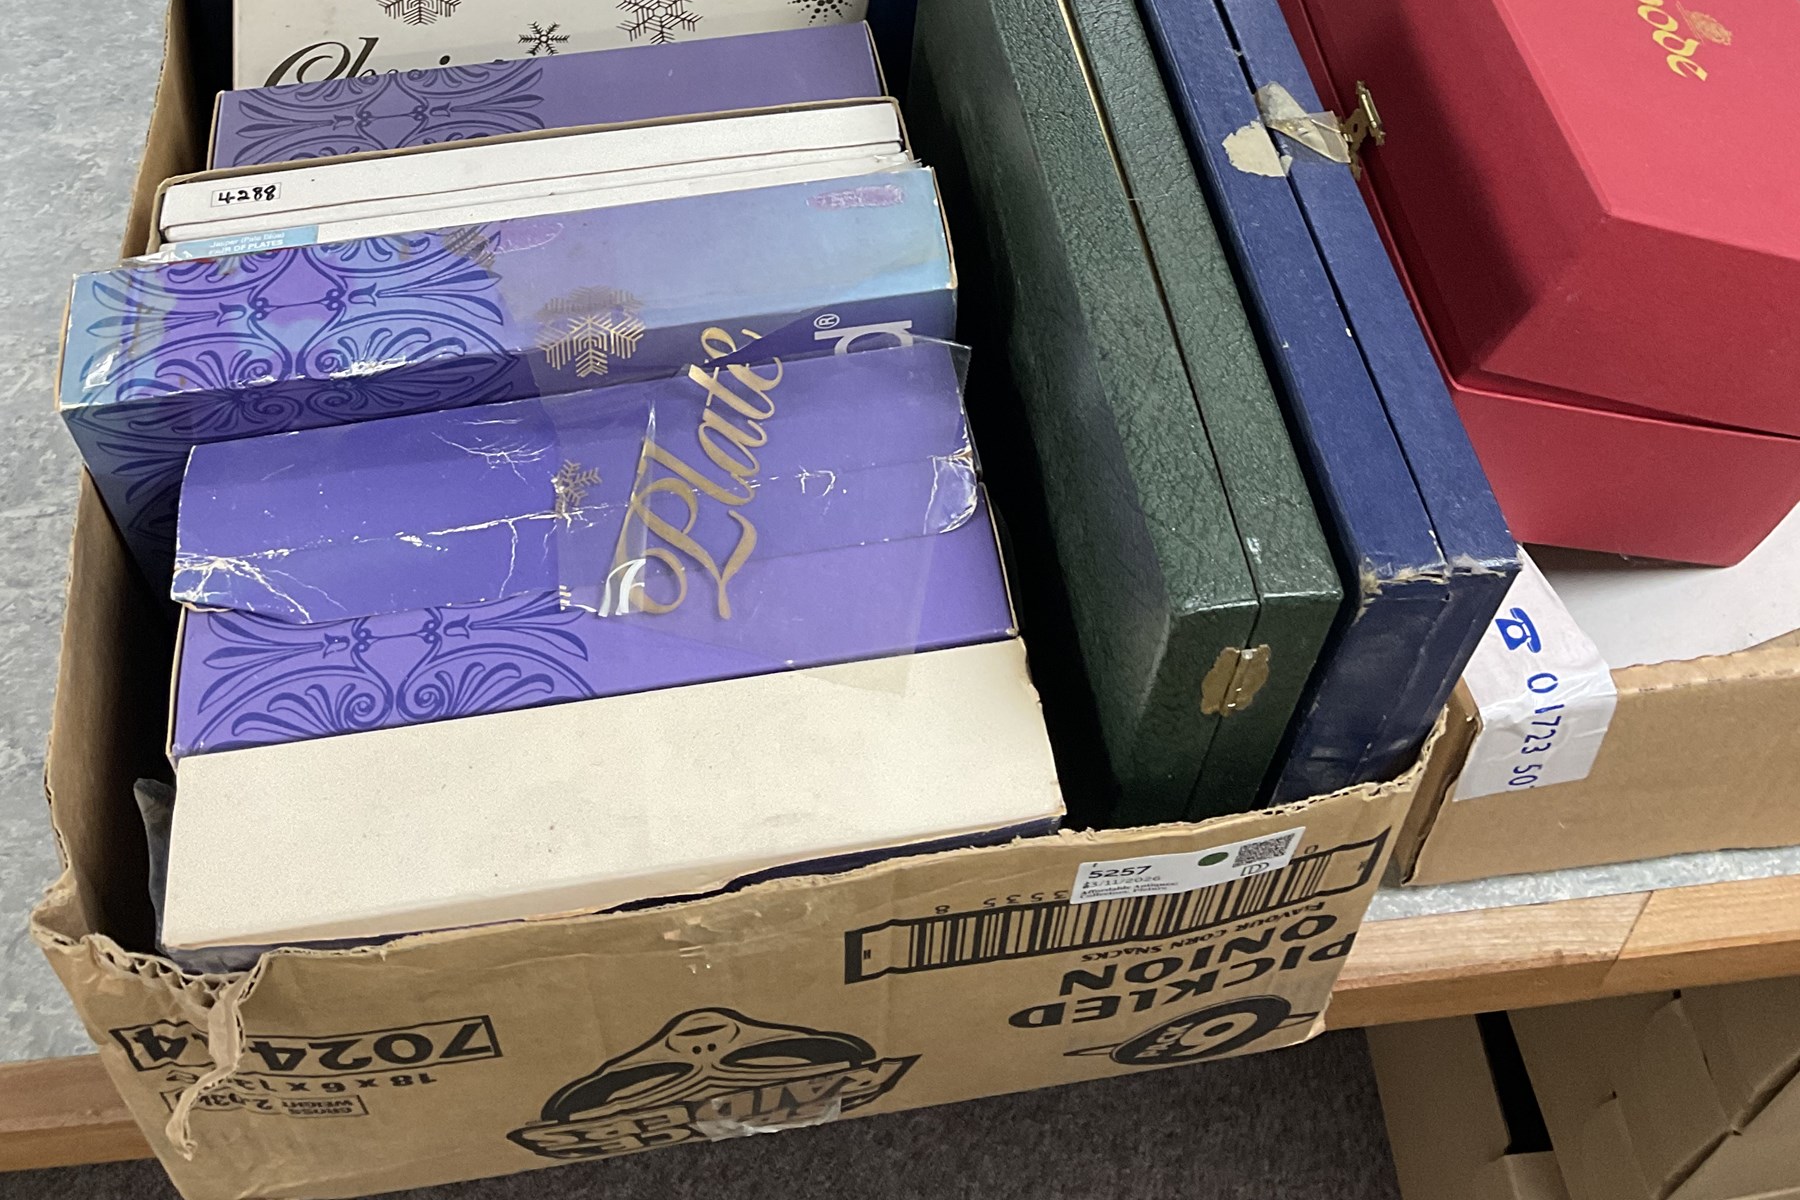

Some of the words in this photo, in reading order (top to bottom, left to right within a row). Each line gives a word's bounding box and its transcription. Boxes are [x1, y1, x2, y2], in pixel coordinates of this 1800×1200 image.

[247, 239, 284, 250] PLATES
[1088, 865, 1152, 879] 5257
[1170, 929, 1230, 950] CORN
[1060, 915, 1338, 997] ONION
[1081, 944, 1163, 963] SNACKS
[1008, 931, 1357, 1028] PICKLED
[134, 1022, 493, 1072] 70244
[321, 1081, 347, 1094] 6
[389, 1072, 438, 1087] 18
